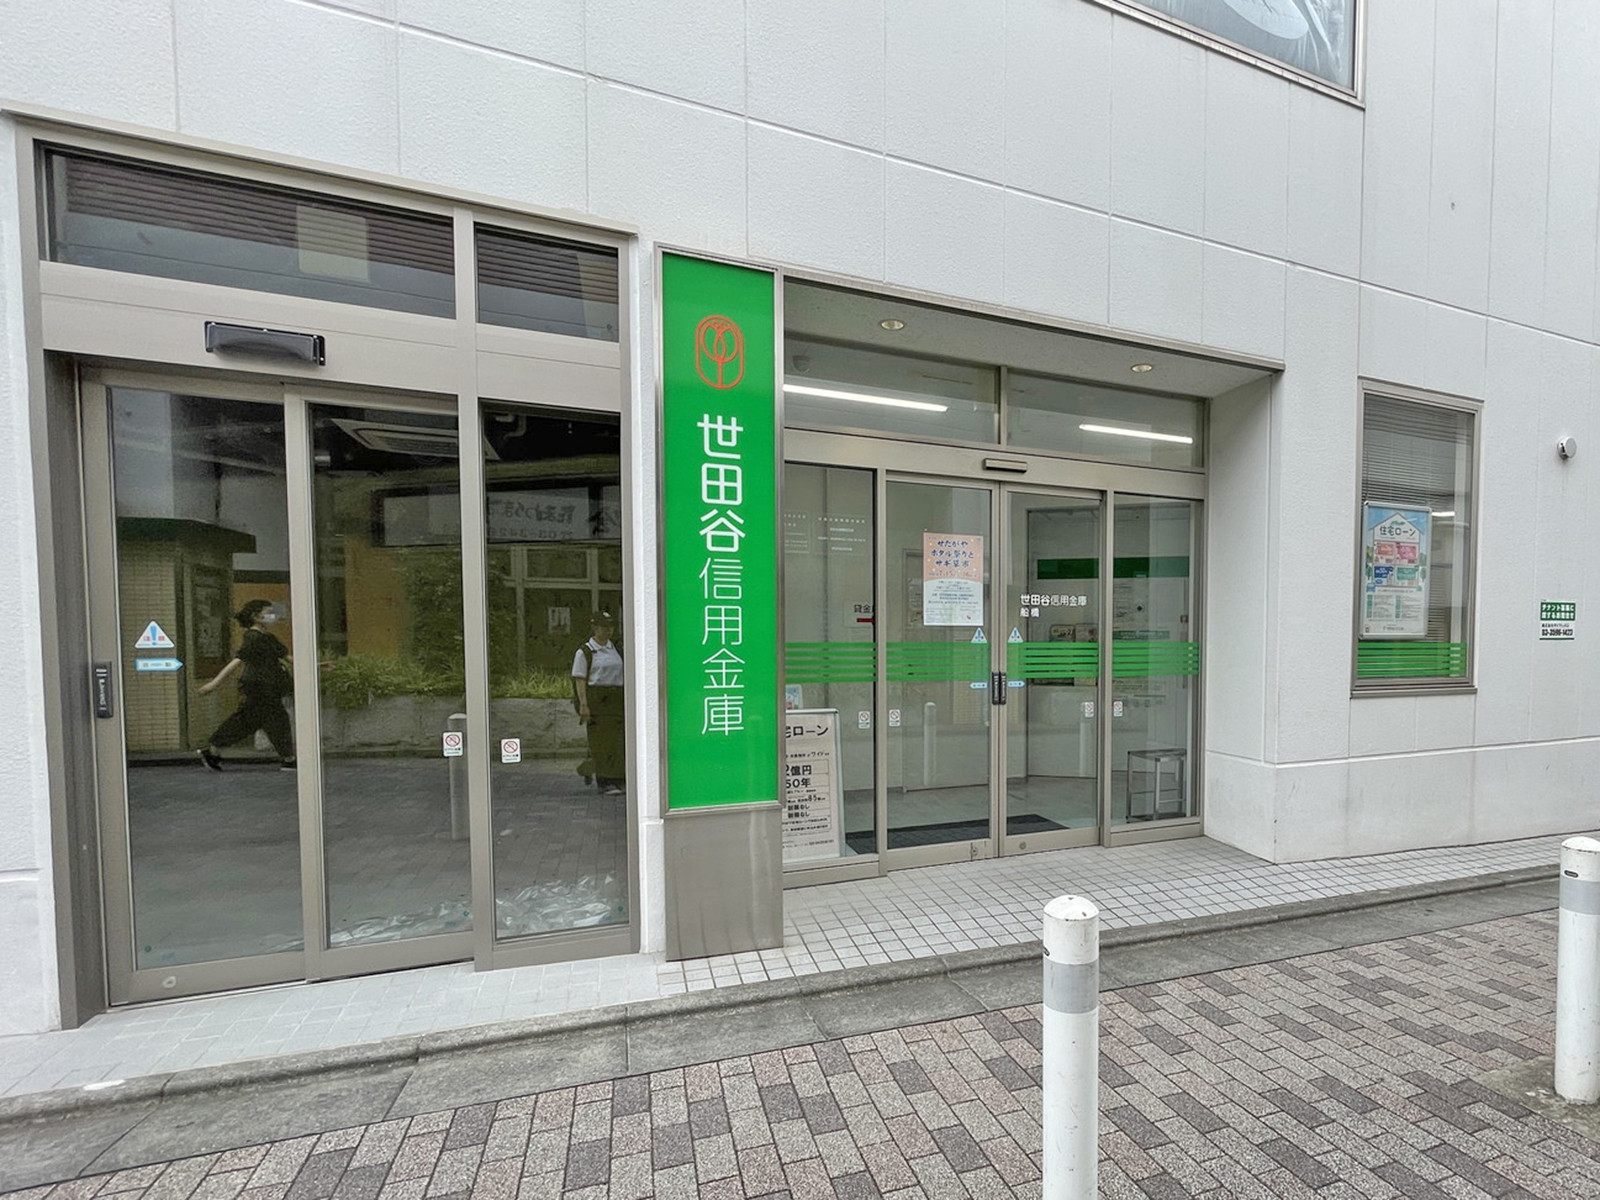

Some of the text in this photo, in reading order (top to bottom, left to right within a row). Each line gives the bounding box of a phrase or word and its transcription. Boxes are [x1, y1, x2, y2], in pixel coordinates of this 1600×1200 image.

[1380, 525, 1416, 536] 住宅ローン
[697, 413, 746, 736] 世田谷信用金庫
[1020, 594, 1087, 607] 世田谷信用金庫
[854, 604, 874, 613] 貸金
